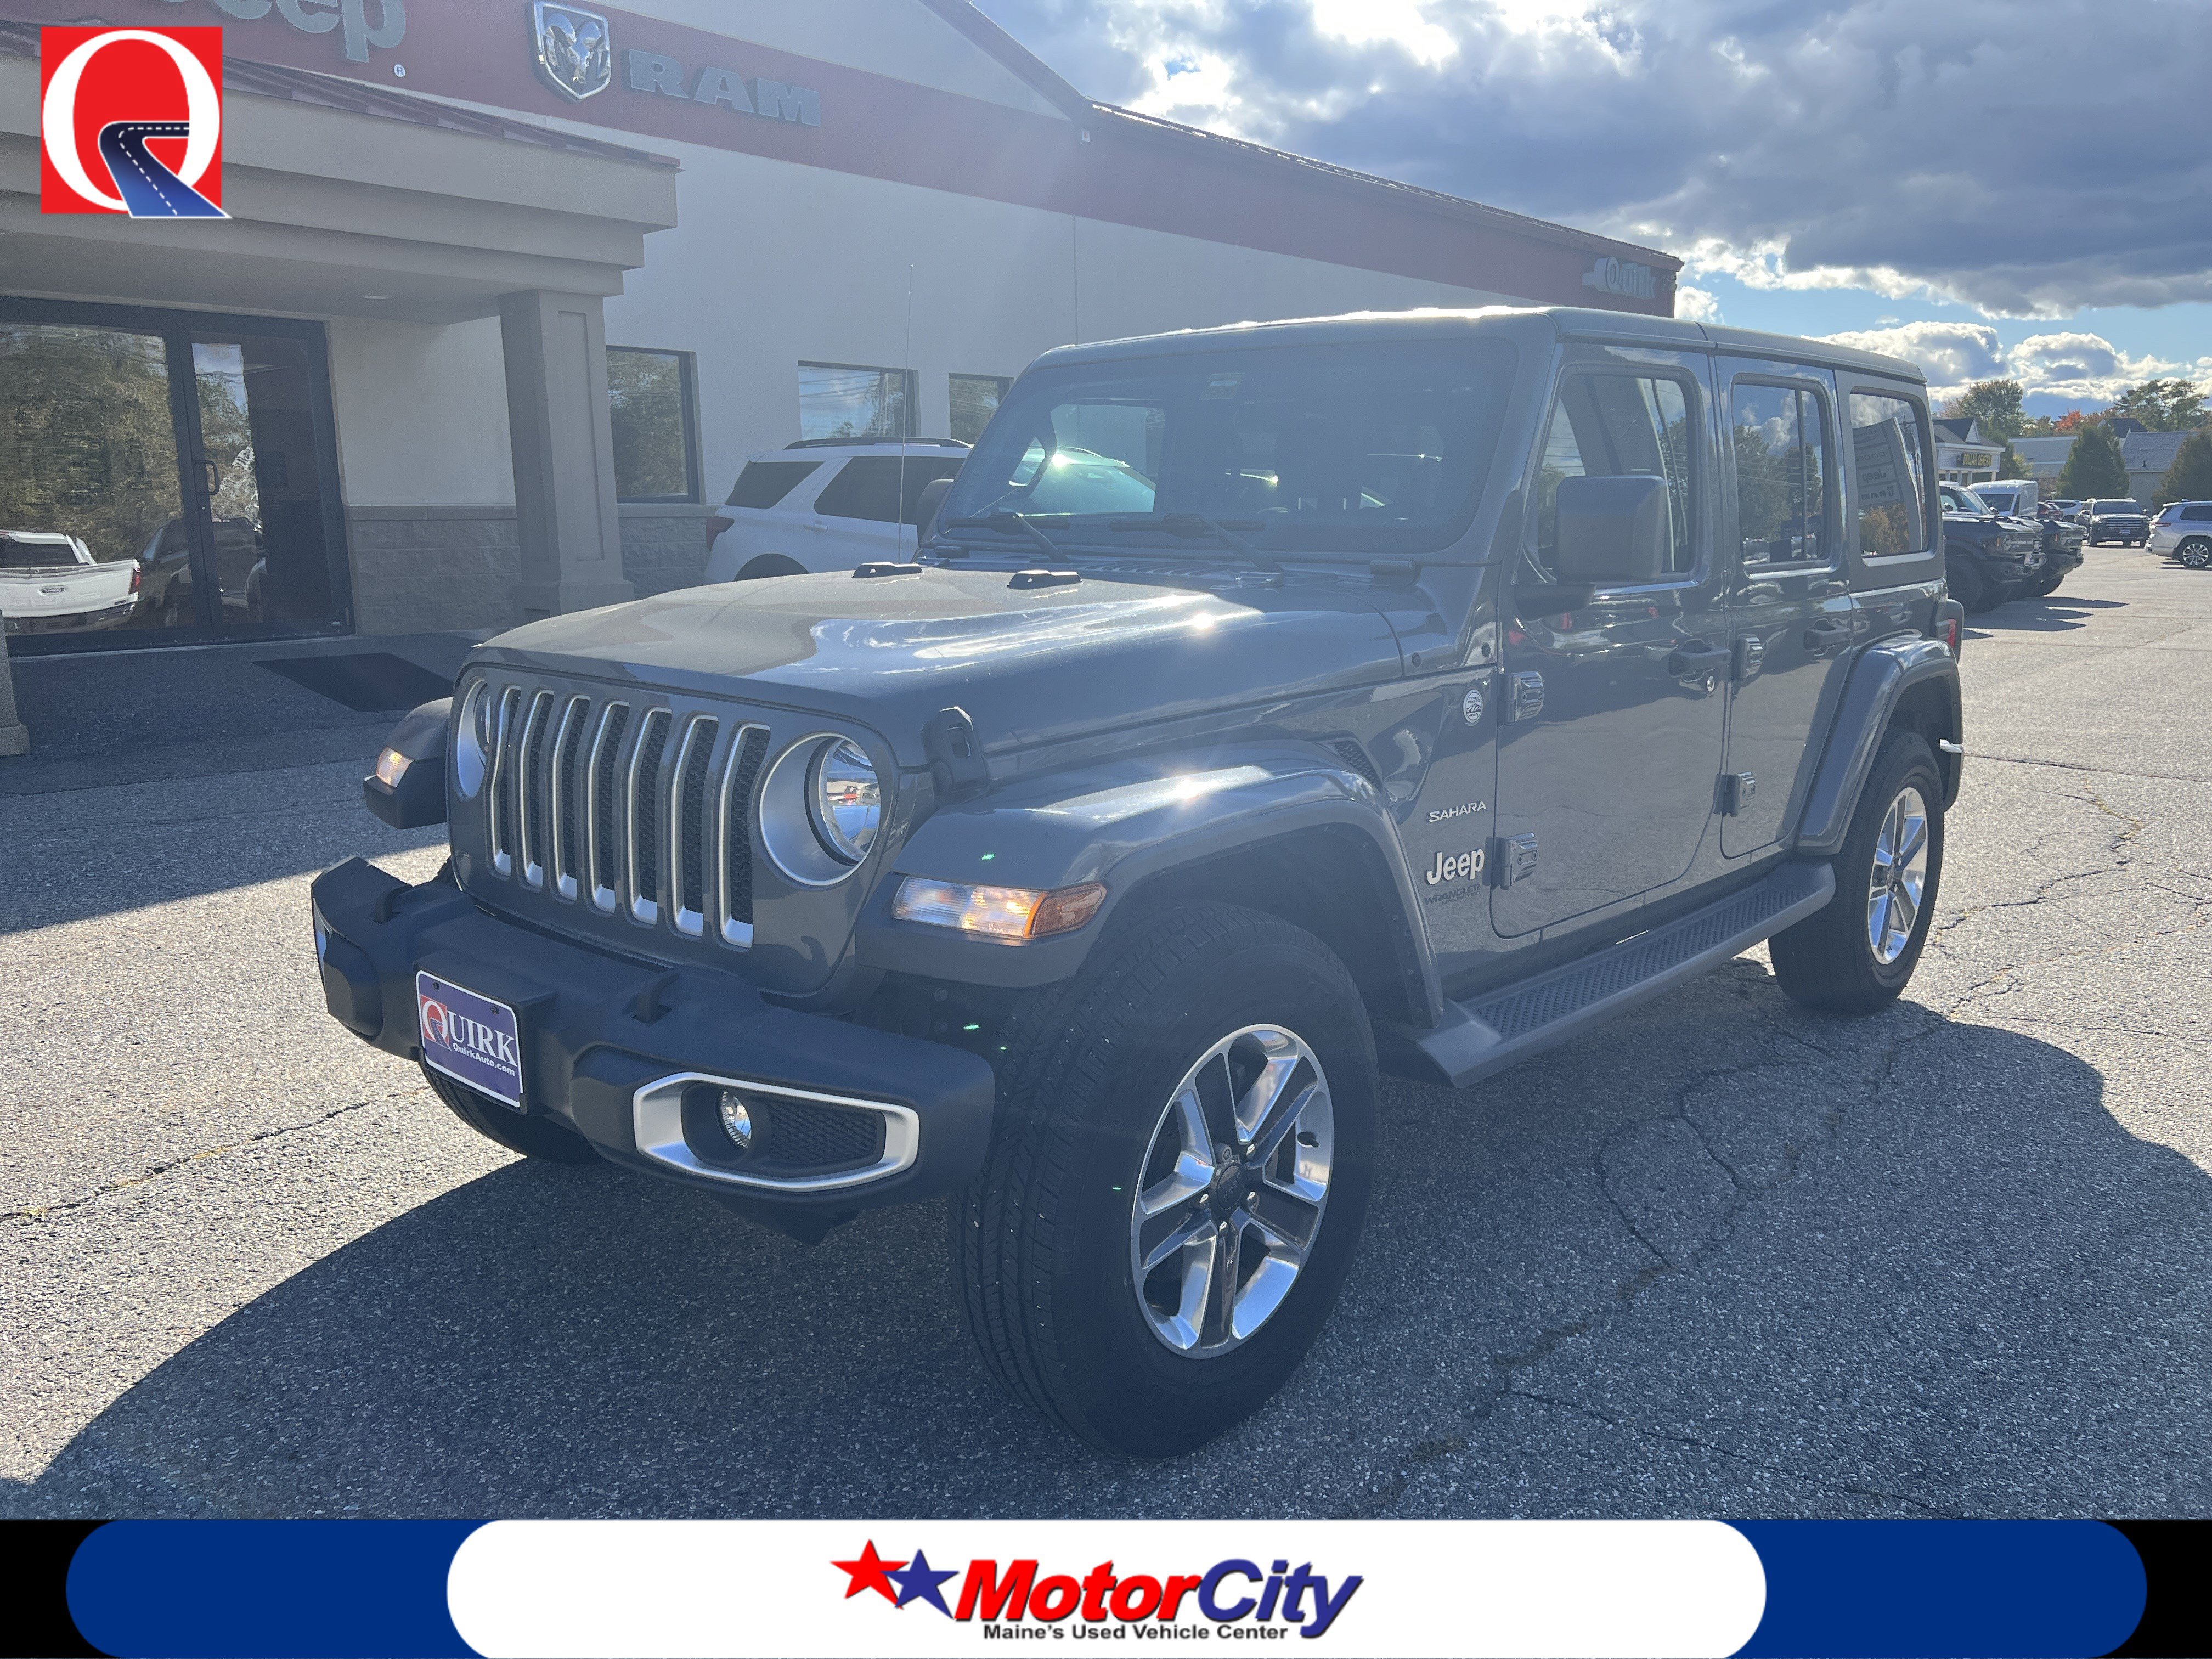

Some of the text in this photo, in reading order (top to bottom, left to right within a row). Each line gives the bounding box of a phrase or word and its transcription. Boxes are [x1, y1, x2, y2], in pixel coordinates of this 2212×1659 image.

[163, 0, 406, 63] ep
[628, 48, 822, 127] RAM
[1429, 800, 1486, 822] SAHARA
[1426, 849, 1485, 885] Jeep
[1424, 883, 1480, 905] WRANGLER
[422, 1000, 518, 1067] QUIRK
[453, 1042, 515, 1076] QuirkAuto.com
